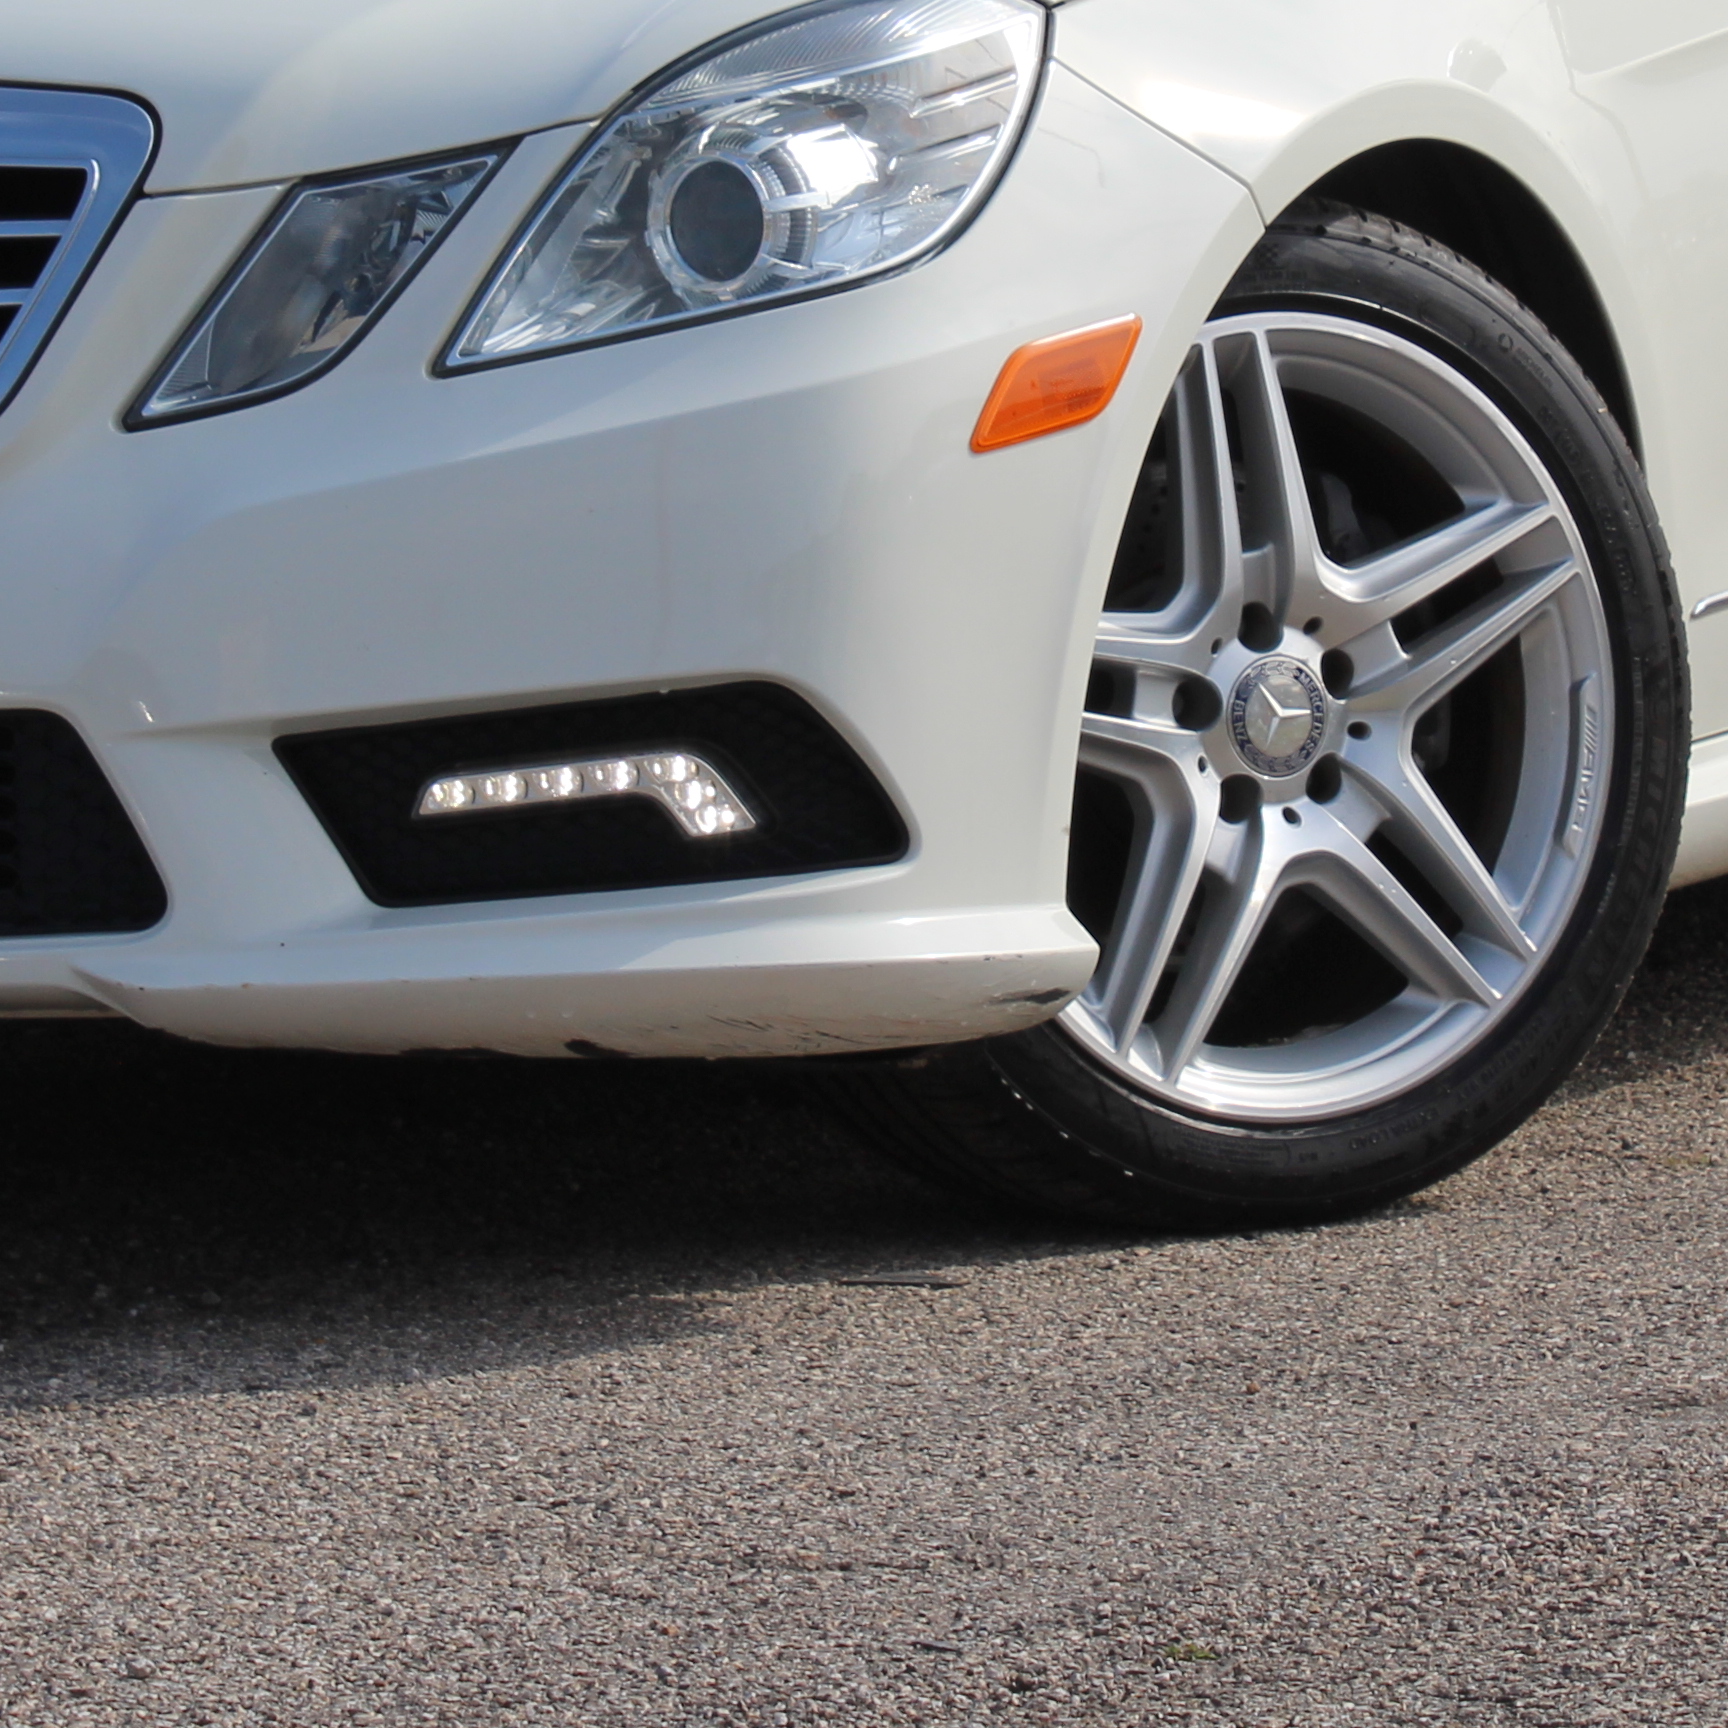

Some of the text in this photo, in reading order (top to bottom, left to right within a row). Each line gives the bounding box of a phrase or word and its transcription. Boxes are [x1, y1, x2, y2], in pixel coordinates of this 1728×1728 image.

[1233, 700, 1250, 748] BENZ
[1298, 671, 1324, 753] MERCEDES
[1579, 736, 1670, 990] MICHELIN
[1347, 1104, 1440, 1154] EXTRA LOAD
